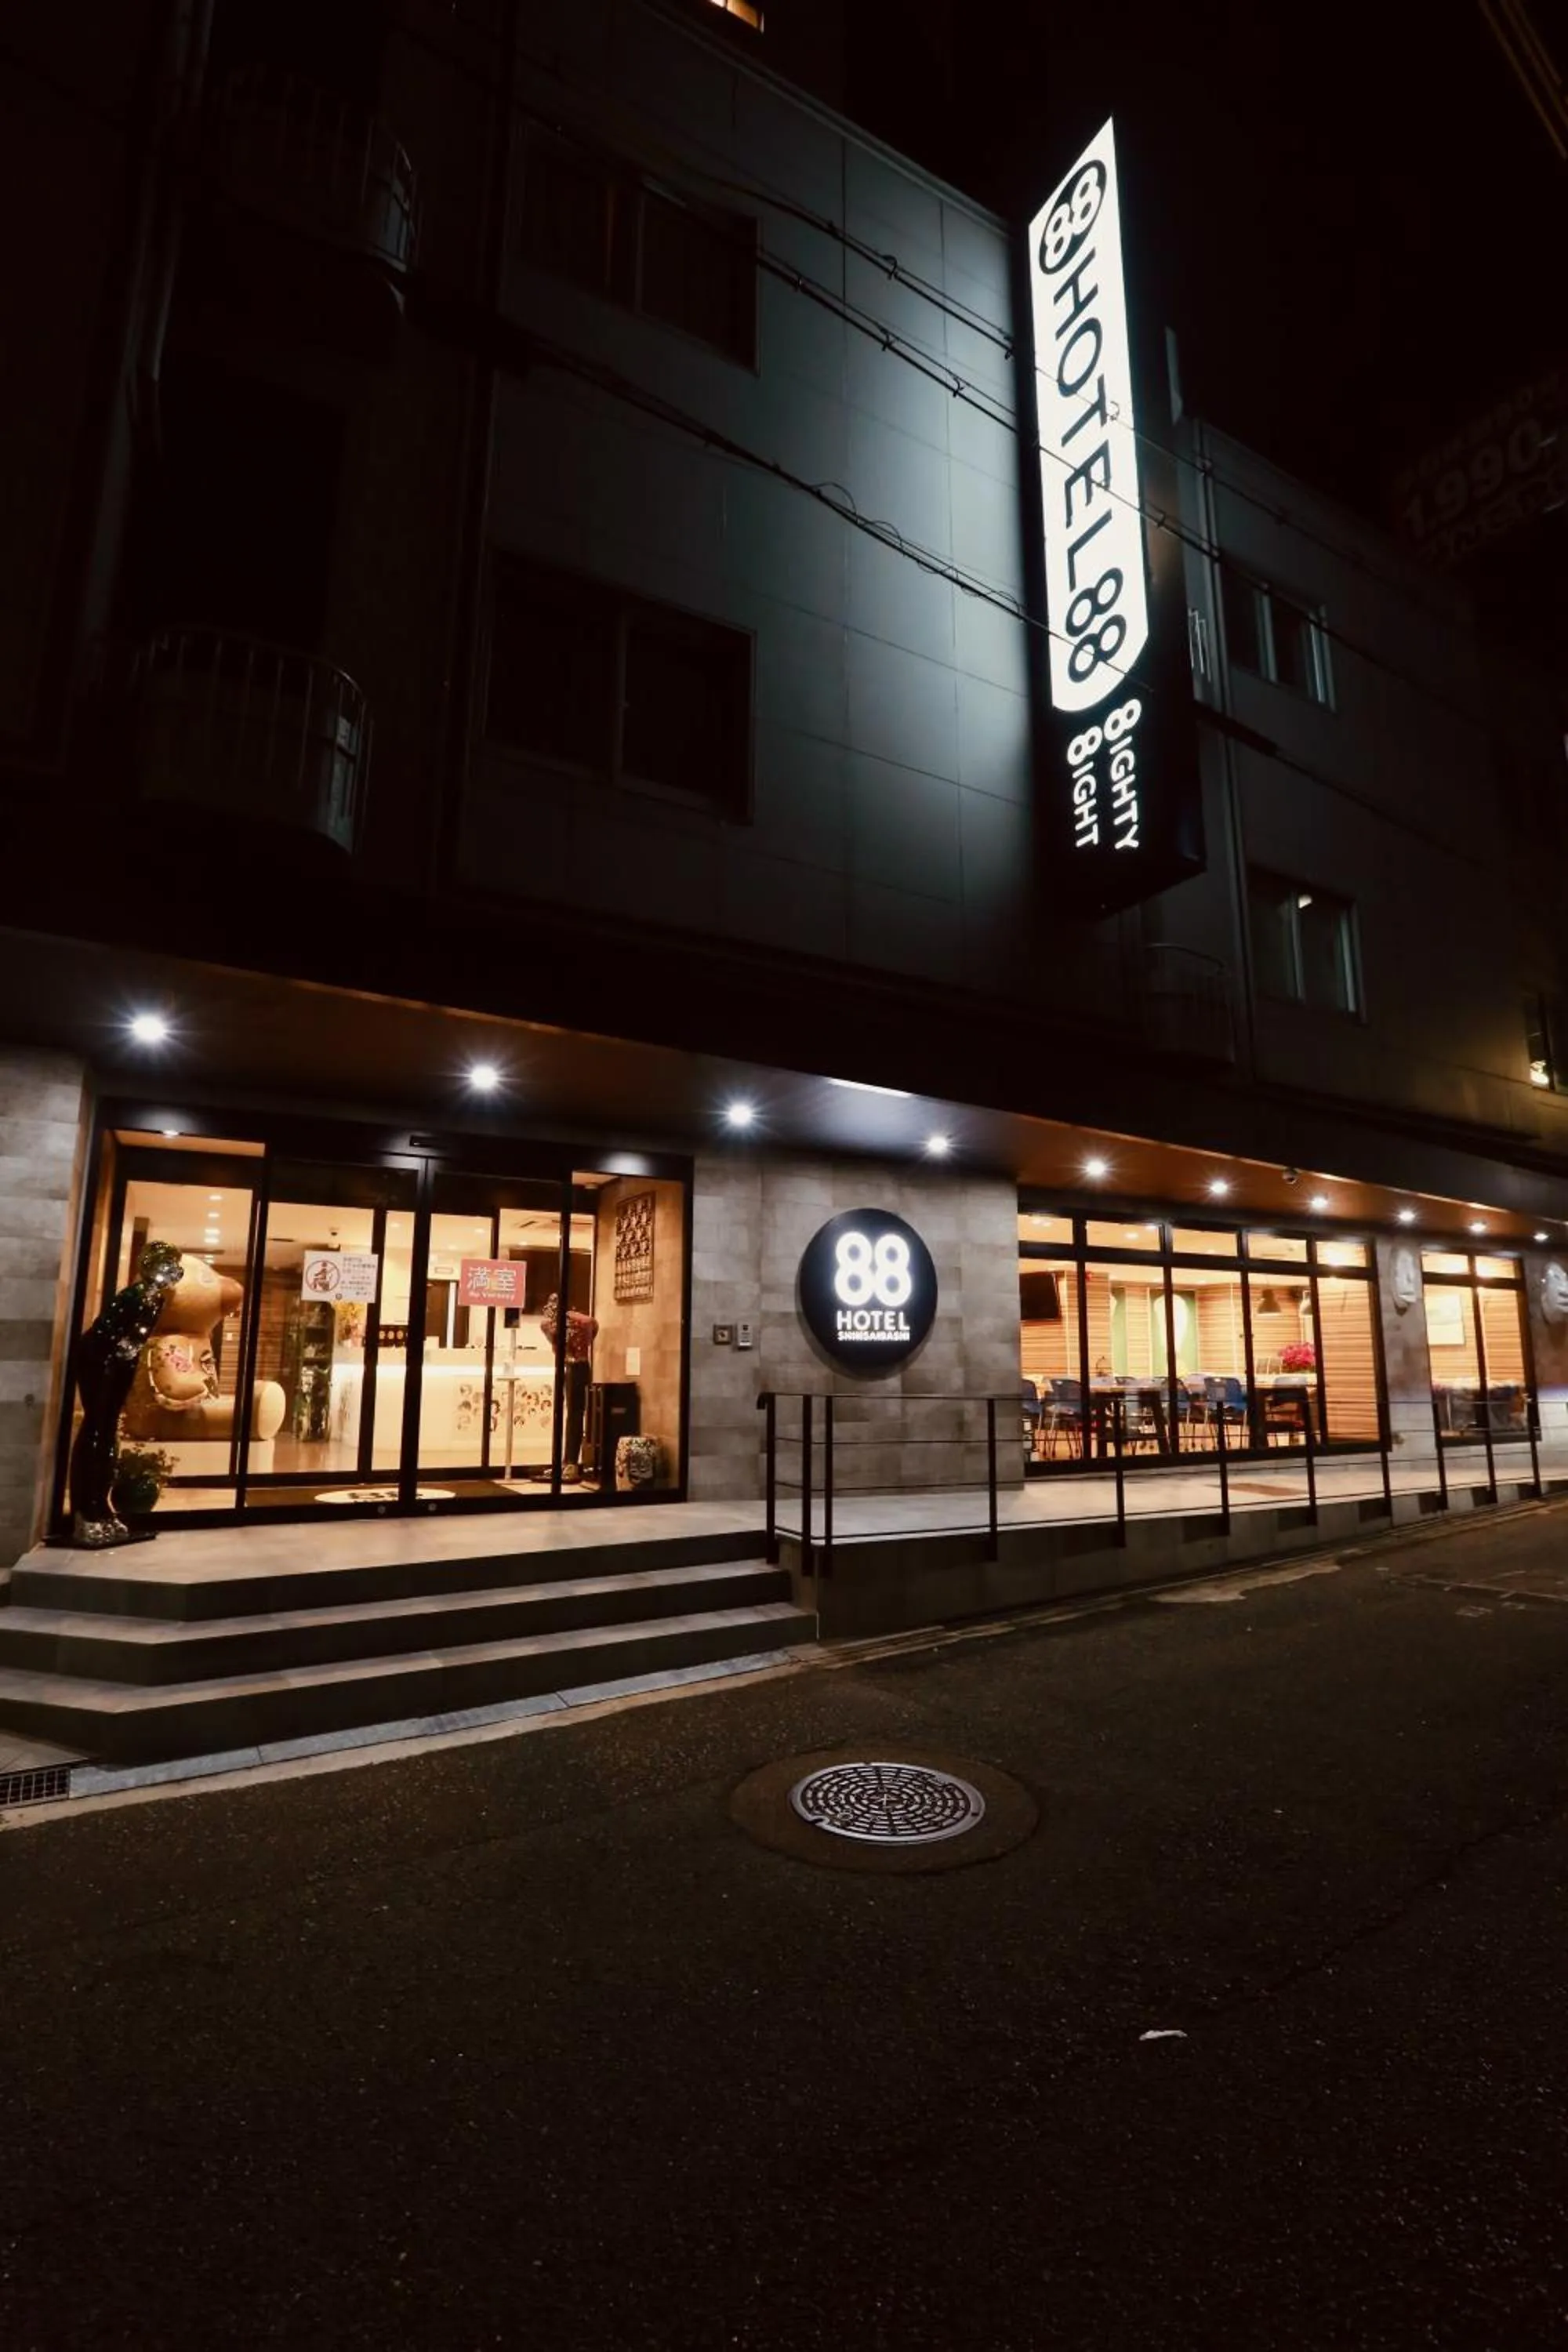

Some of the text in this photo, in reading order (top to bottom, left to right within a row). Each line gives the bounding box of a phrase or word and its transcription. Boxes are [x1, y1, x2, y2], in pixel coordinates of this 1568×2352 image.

[1044, 166, 1101, 272] 88
[834, 1231, 912, 1307] 88
[837, 1310, 910, 1330] HOTEL
